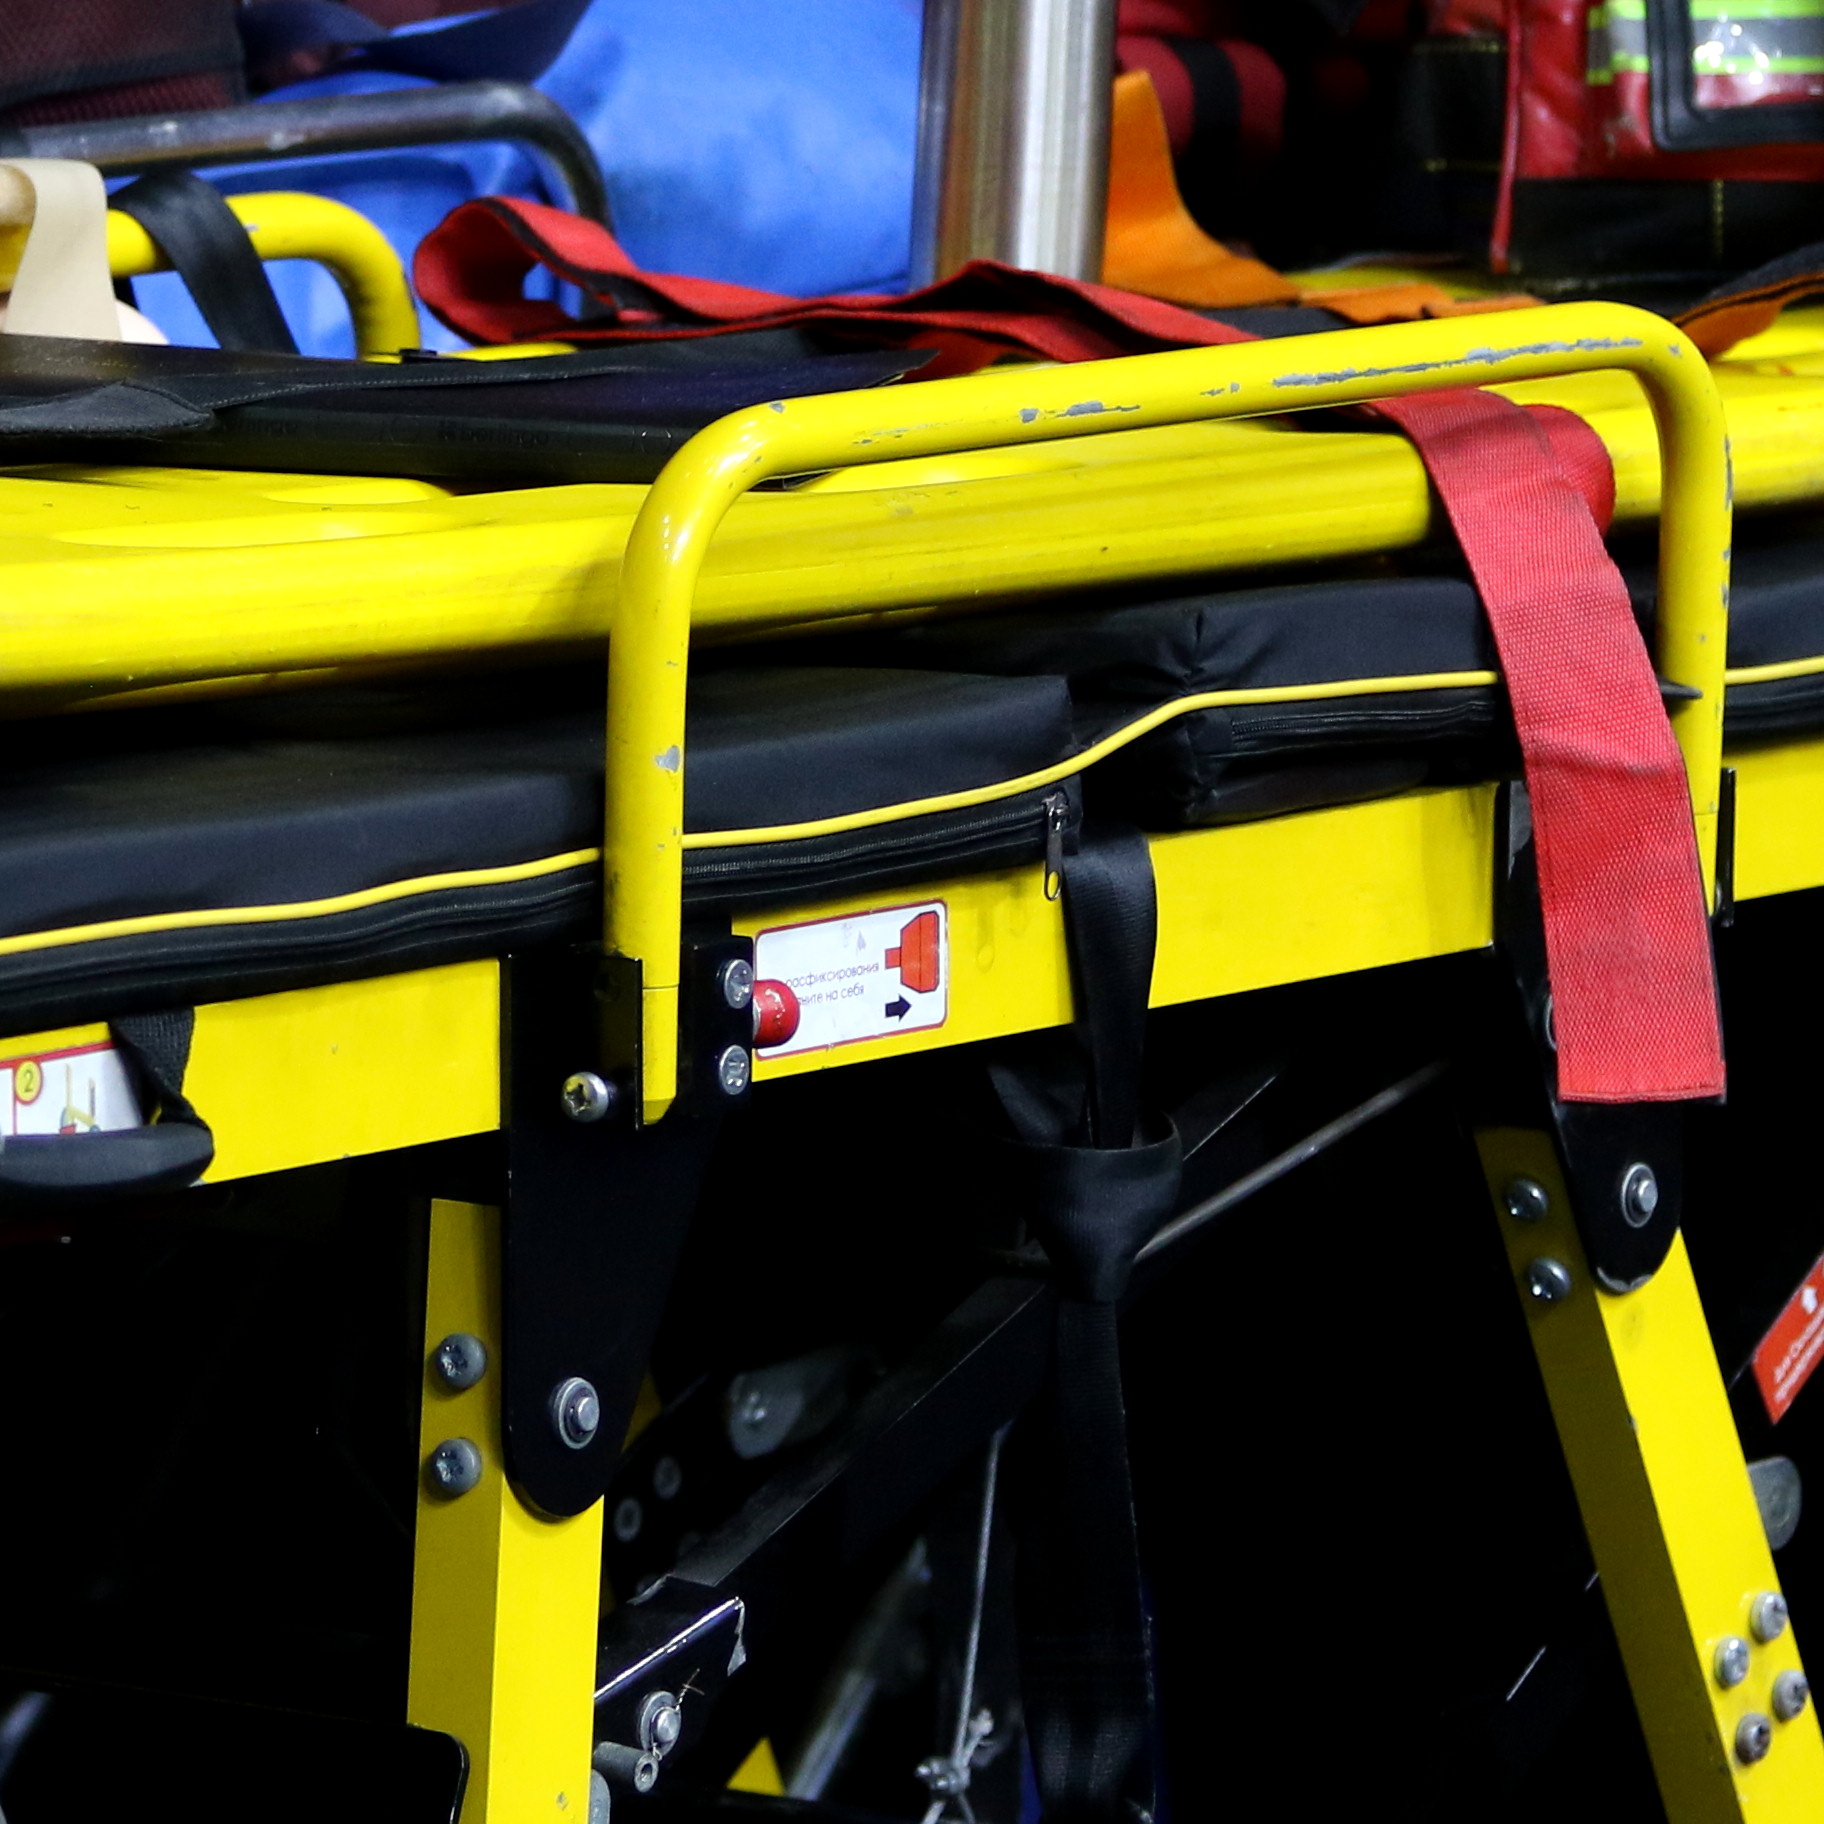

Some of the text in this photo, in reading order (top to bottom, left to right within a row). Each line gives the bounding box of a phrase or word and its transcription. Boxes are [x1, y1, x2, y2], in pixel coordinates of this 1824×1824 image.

[826, 989, 838, 1001] на
[841, 982, 864, 999] себя
[23, 1069, 34, 1093] 2
